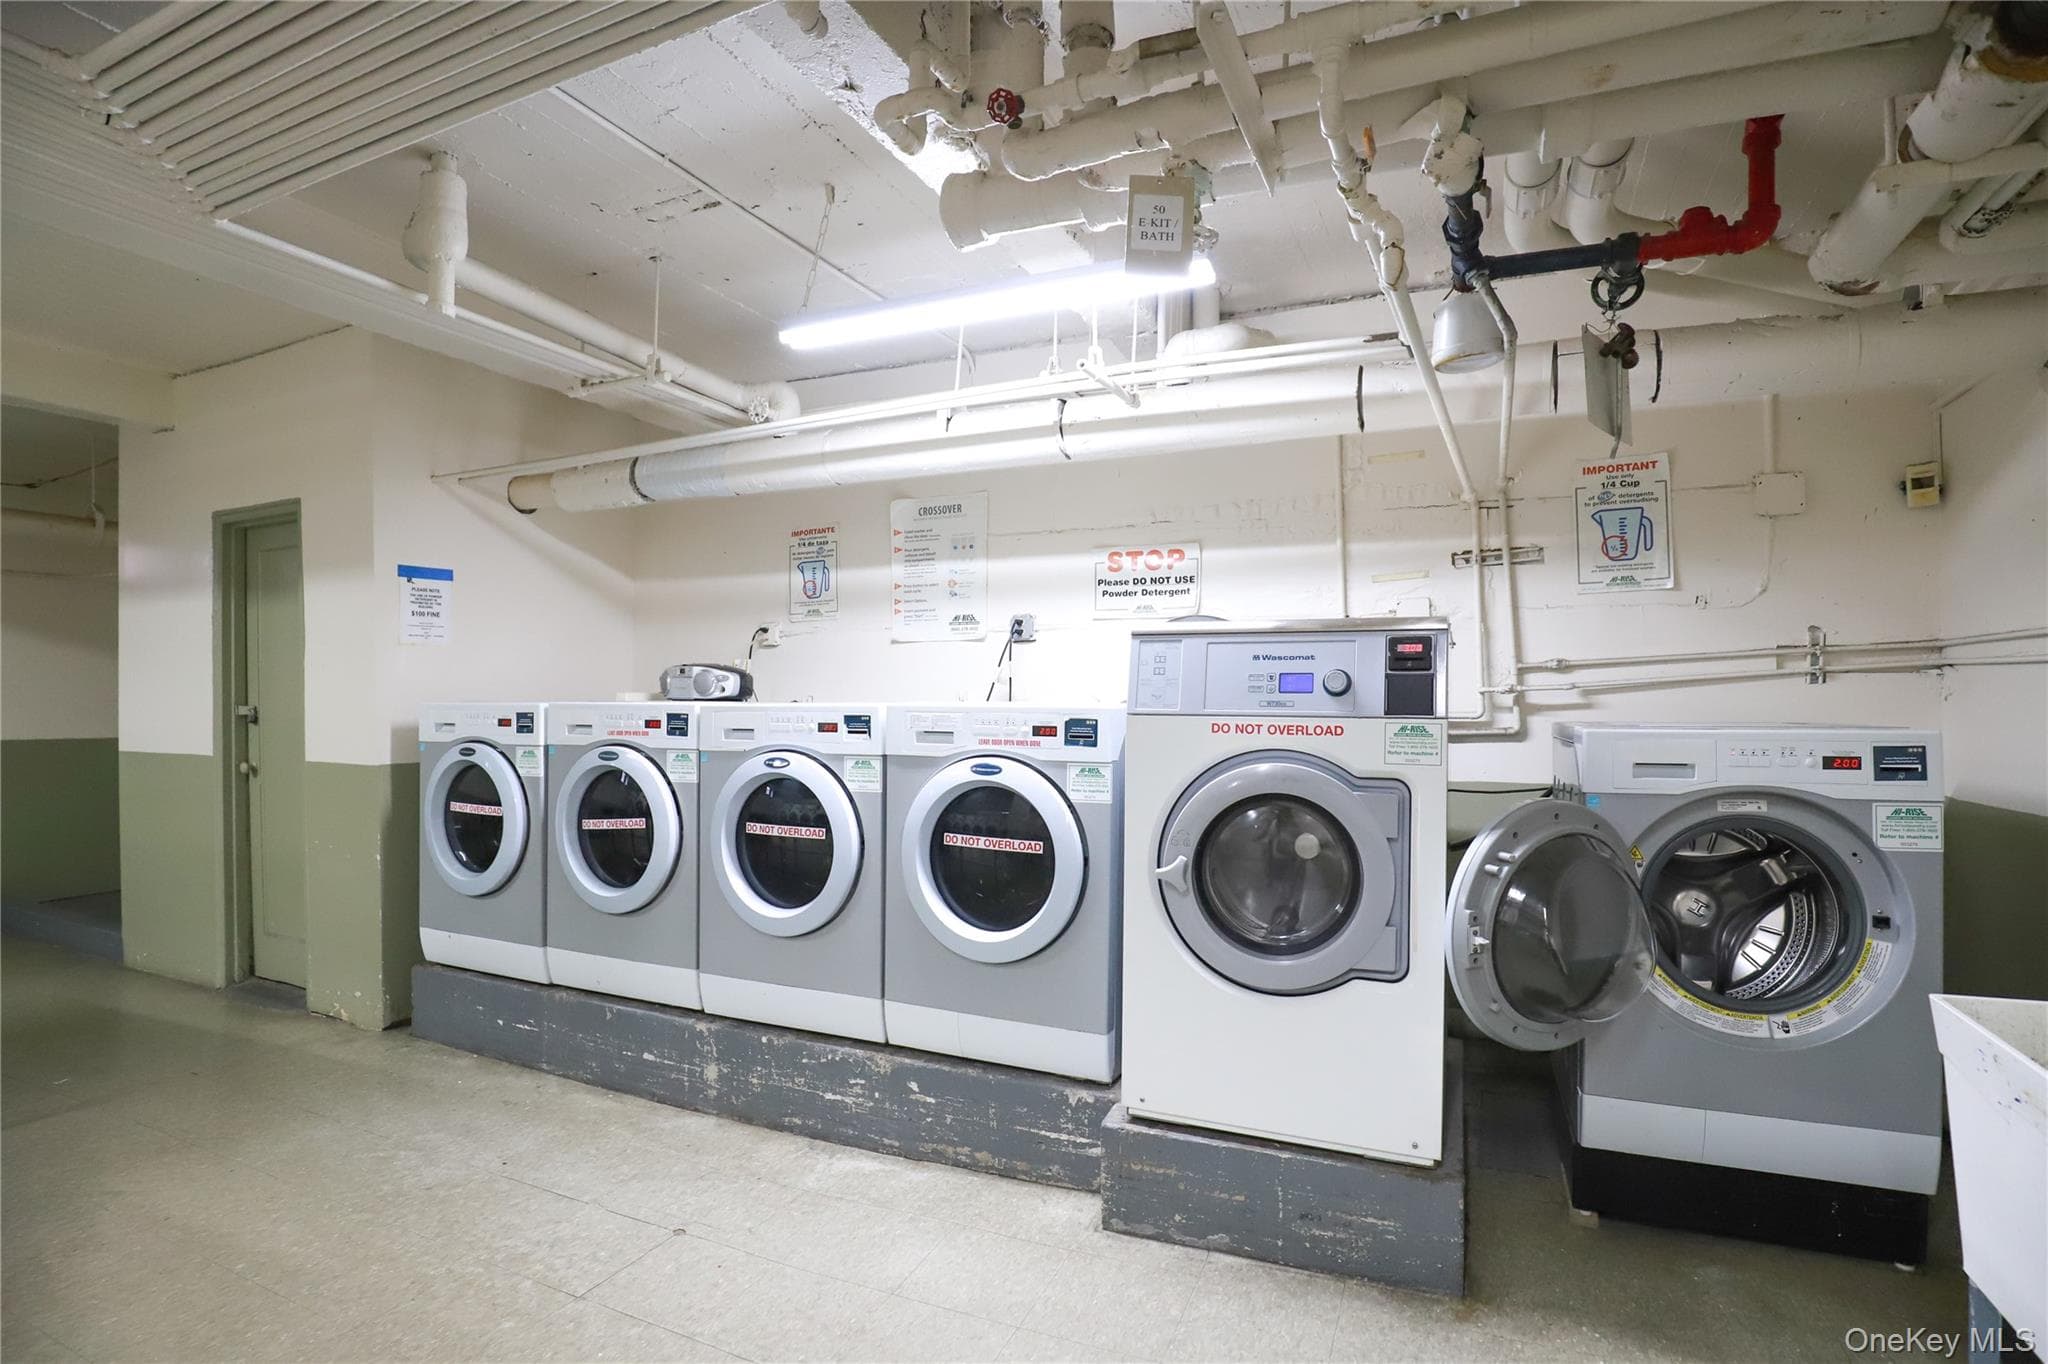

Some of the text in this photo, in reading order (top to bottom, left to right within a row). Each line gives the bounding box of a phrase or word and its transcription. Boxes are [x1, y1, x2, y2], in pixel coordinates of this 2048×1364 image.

[1152, 205, 1166, 214] 50
[1140, 231, 1174, 241] BATH
[1582, 460, 1658, 475] IMPORTANT
[1621, 472, 1634, 480] only
[1620, 480, 1640, 488] Cup
[1618, 491, 1654, 499] detergents
[918, 504, 962, 517] CROSSOVER
[791, 527, 836, 538] IMPORTANTE
[1108, 548, 1185, 572] STOP
[1098, 576, 1196, 586] Please DO NOT USE
[1102, 588, 1190, 598] Powder Detergent
[1211, 722, 1344, 736] DO NOT OVERLOAD
[469, 804, 502, 814] OVERLOAD
[592, 820, 605, 828] NOT
[606, 820, 644, 828] OVERLOAD
[747, 824, 824, 838] DO NOT OVERLOAD
[945, 834, 1042, 852] DO NOT OVERLOAD
